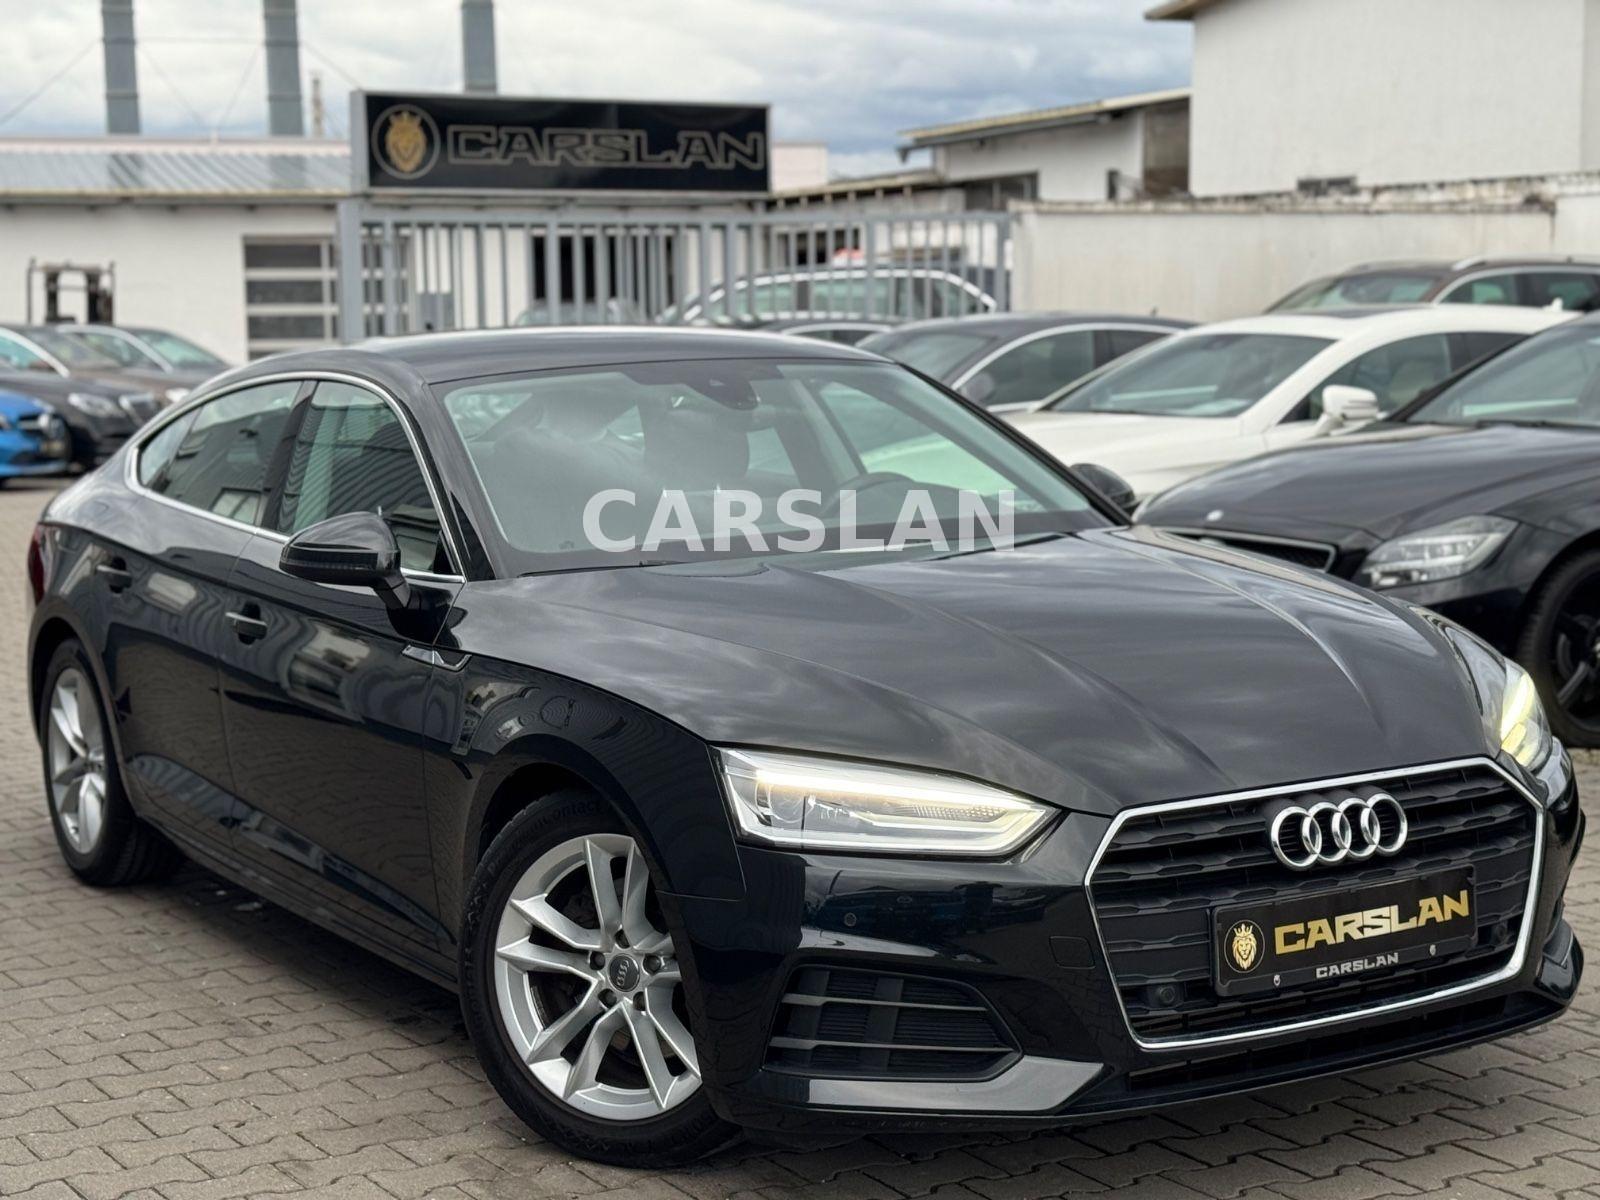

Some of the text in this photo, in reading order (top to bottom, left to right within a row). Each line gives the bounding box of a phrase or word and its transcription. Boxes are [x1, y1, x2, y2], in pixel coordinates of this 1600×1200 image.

[447, 125, 764, 170] CARSLAN
[1274, 890, 1469, 955] CARSLAN
[1316, 952, 1399, 979] CARSLAN
